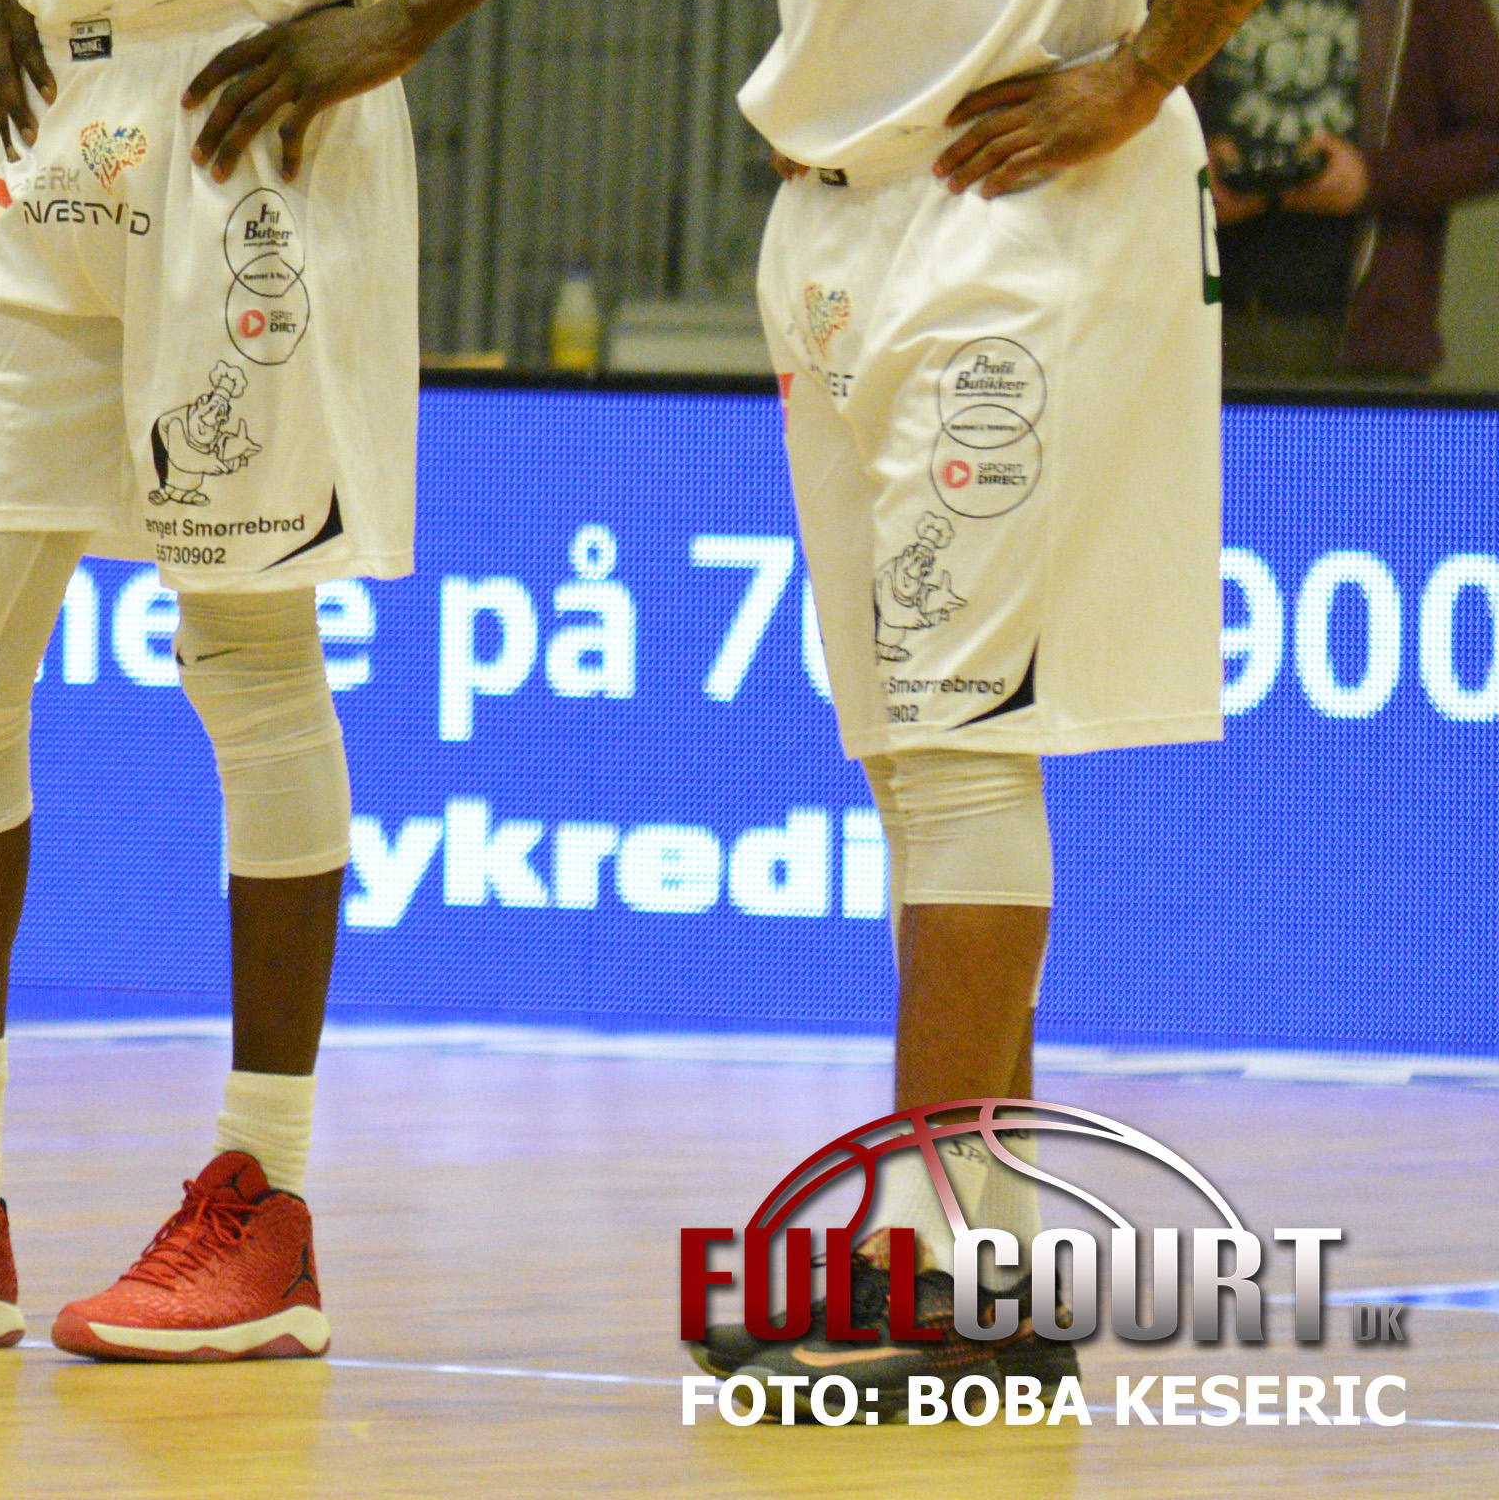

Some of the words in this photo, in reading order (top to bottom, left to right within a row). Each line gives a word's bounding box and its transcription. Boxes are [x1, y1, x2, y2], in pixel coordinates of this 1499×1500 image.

[22, 199, 152, 236] NÆSTVD
[977, 474, 1028, 486] DIRECT
[182, 514, 305, 537] Smørrebrød
[437, 523, 640, 742] på
